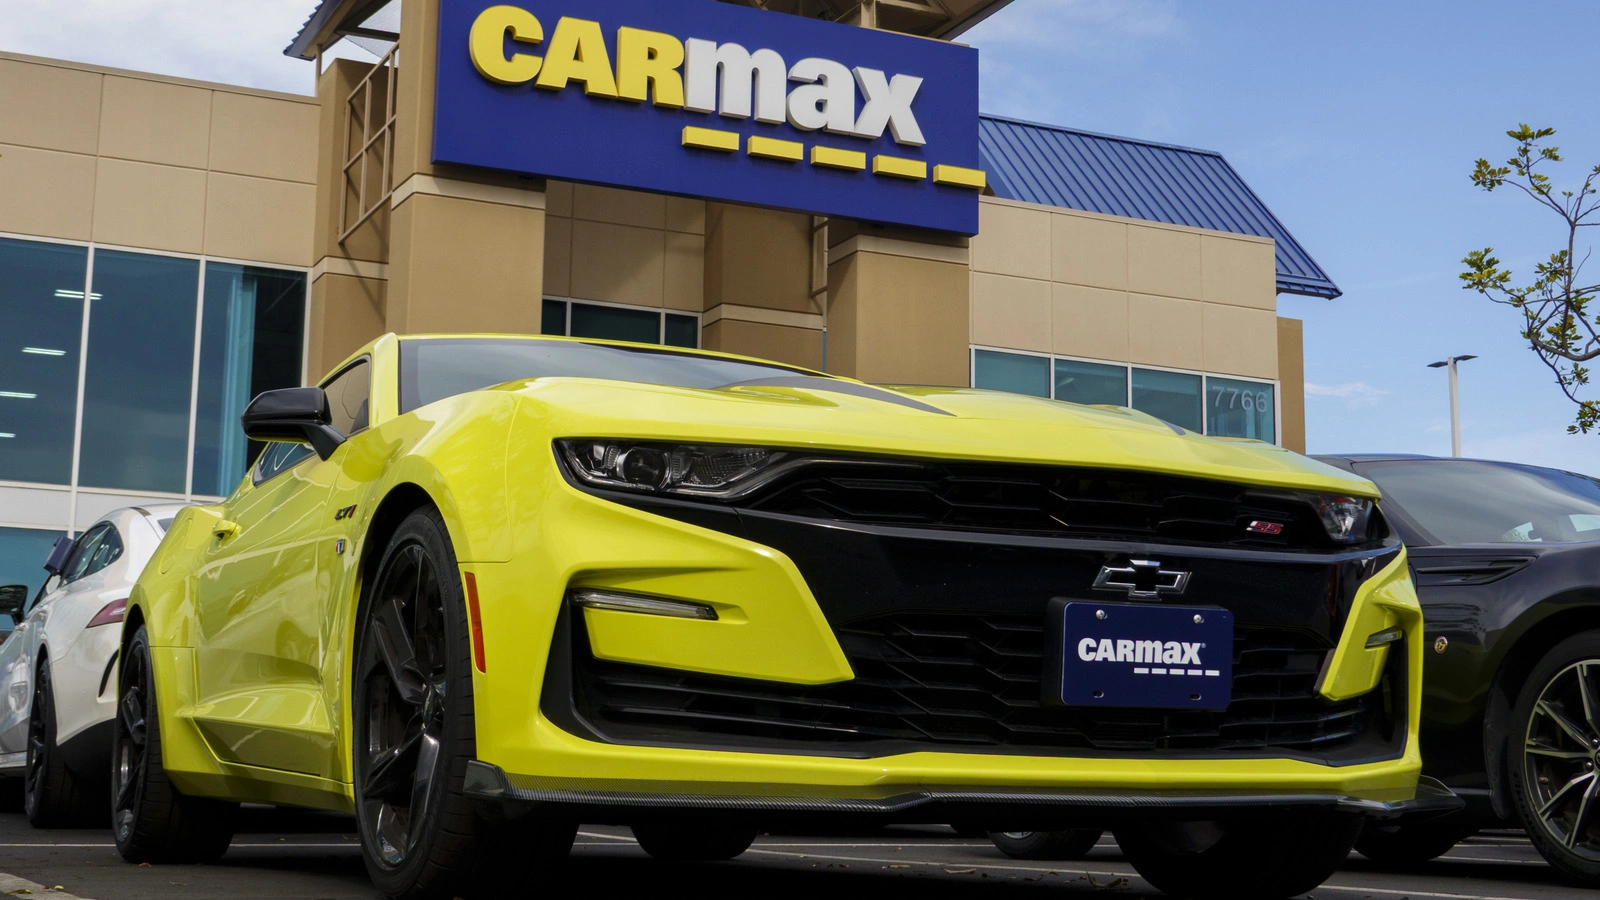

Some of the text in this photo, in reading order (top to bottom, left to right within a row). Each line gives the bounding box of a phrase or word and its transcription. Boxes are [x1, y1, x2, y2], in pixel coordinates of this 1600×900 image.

[469, 5, 926, 146] CARmax
[1212, 385, 1268, 413] 7766
[1246, 520, 1284, 535] SS
